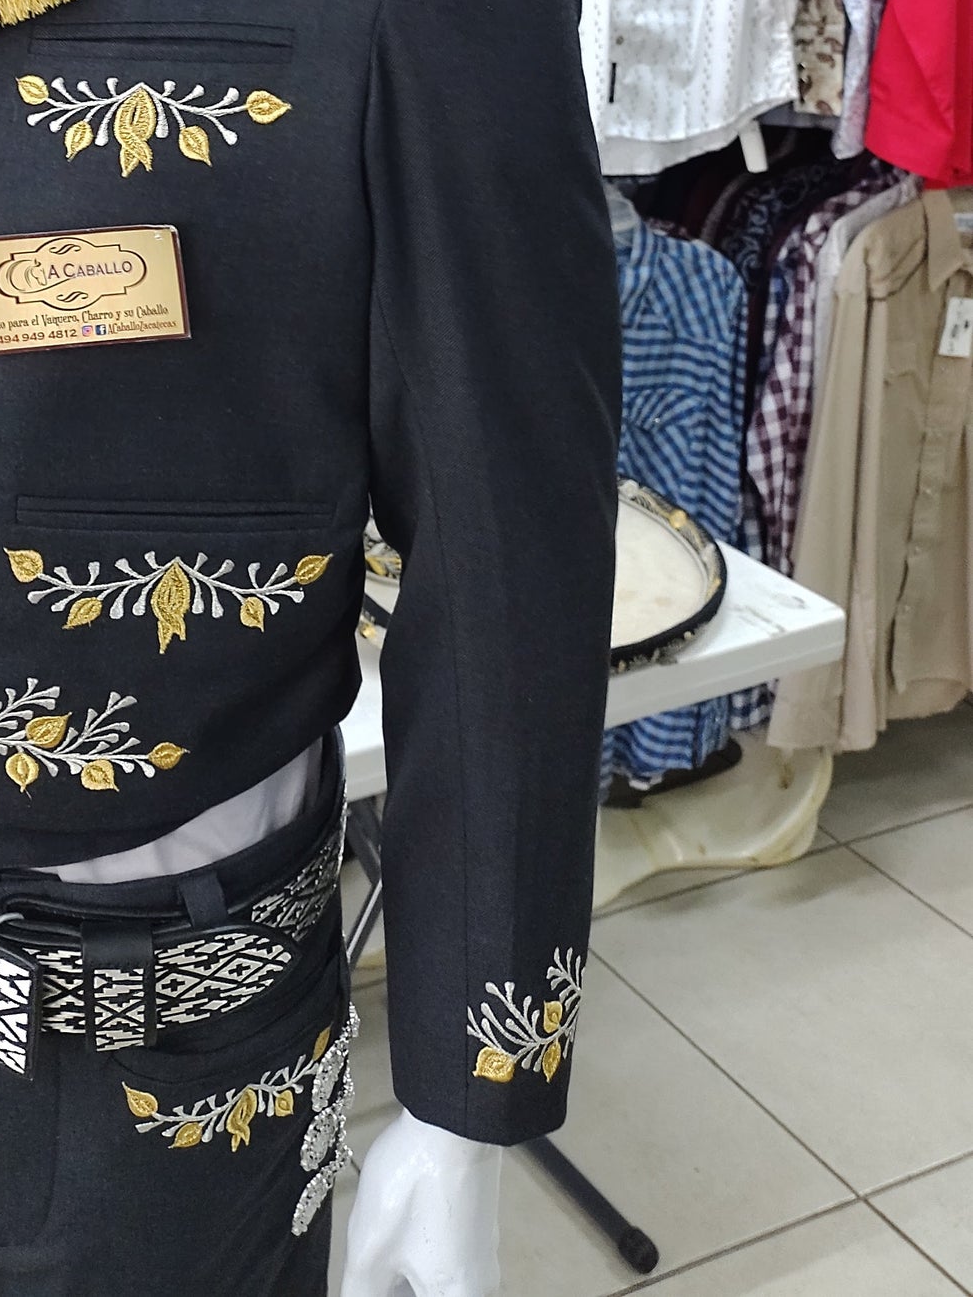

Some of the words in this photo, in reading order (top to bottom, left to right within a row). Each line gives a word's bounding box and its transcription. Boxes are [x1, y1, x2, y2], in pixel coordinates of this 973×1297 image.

[47, 264, 60, 280] A
[63, 260, 133, 279] CABALLO
[8, 318, 29, 331] para
[31, 314, 40, 326] el
[81, 309, 114, 324] Charro
[115, 310, 122, 321] y
[123, 308, 134, 318] su
[136, 303, 169, 319] Caballo
[21, 331, 45, 342] 949
[48, 328, 78, 339] 4812
